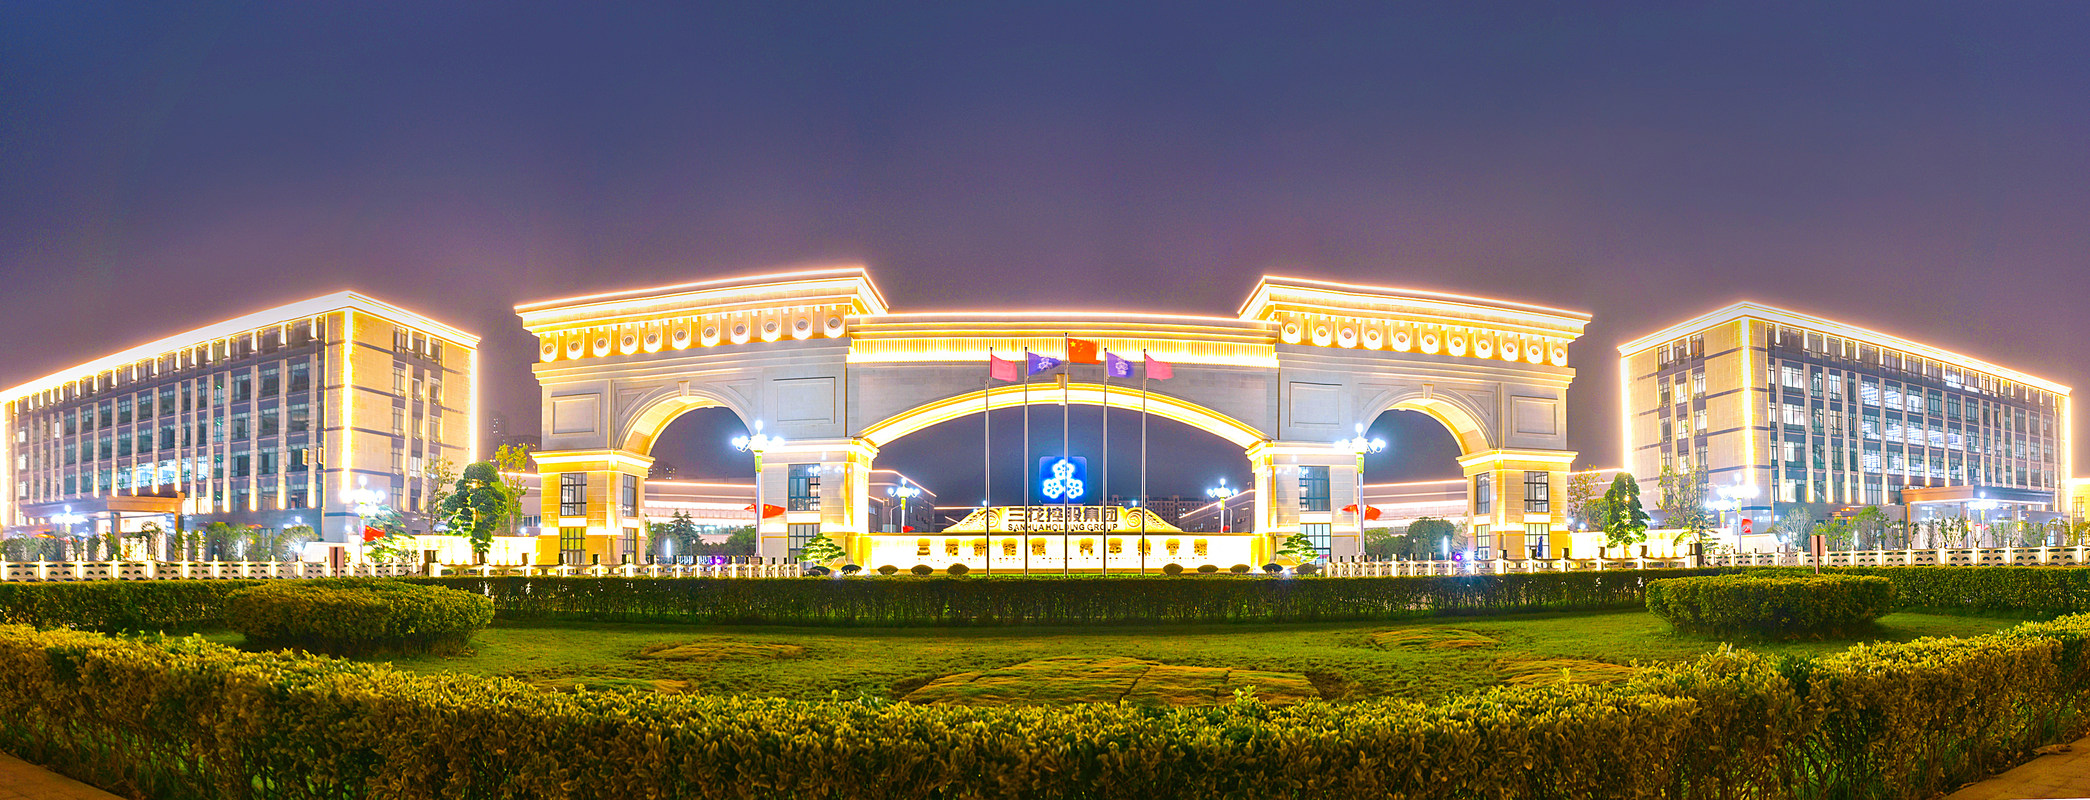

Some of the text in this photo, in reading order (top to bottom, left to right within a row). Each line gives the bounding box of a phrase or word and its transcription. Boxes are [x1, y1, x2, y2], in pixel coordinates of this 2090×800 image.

[1008, 507, 1118, 523] 三花控股集团
[1008, 523, 1044, 531] SANHUA
[1086, 523, 1118, 531] GROUP
